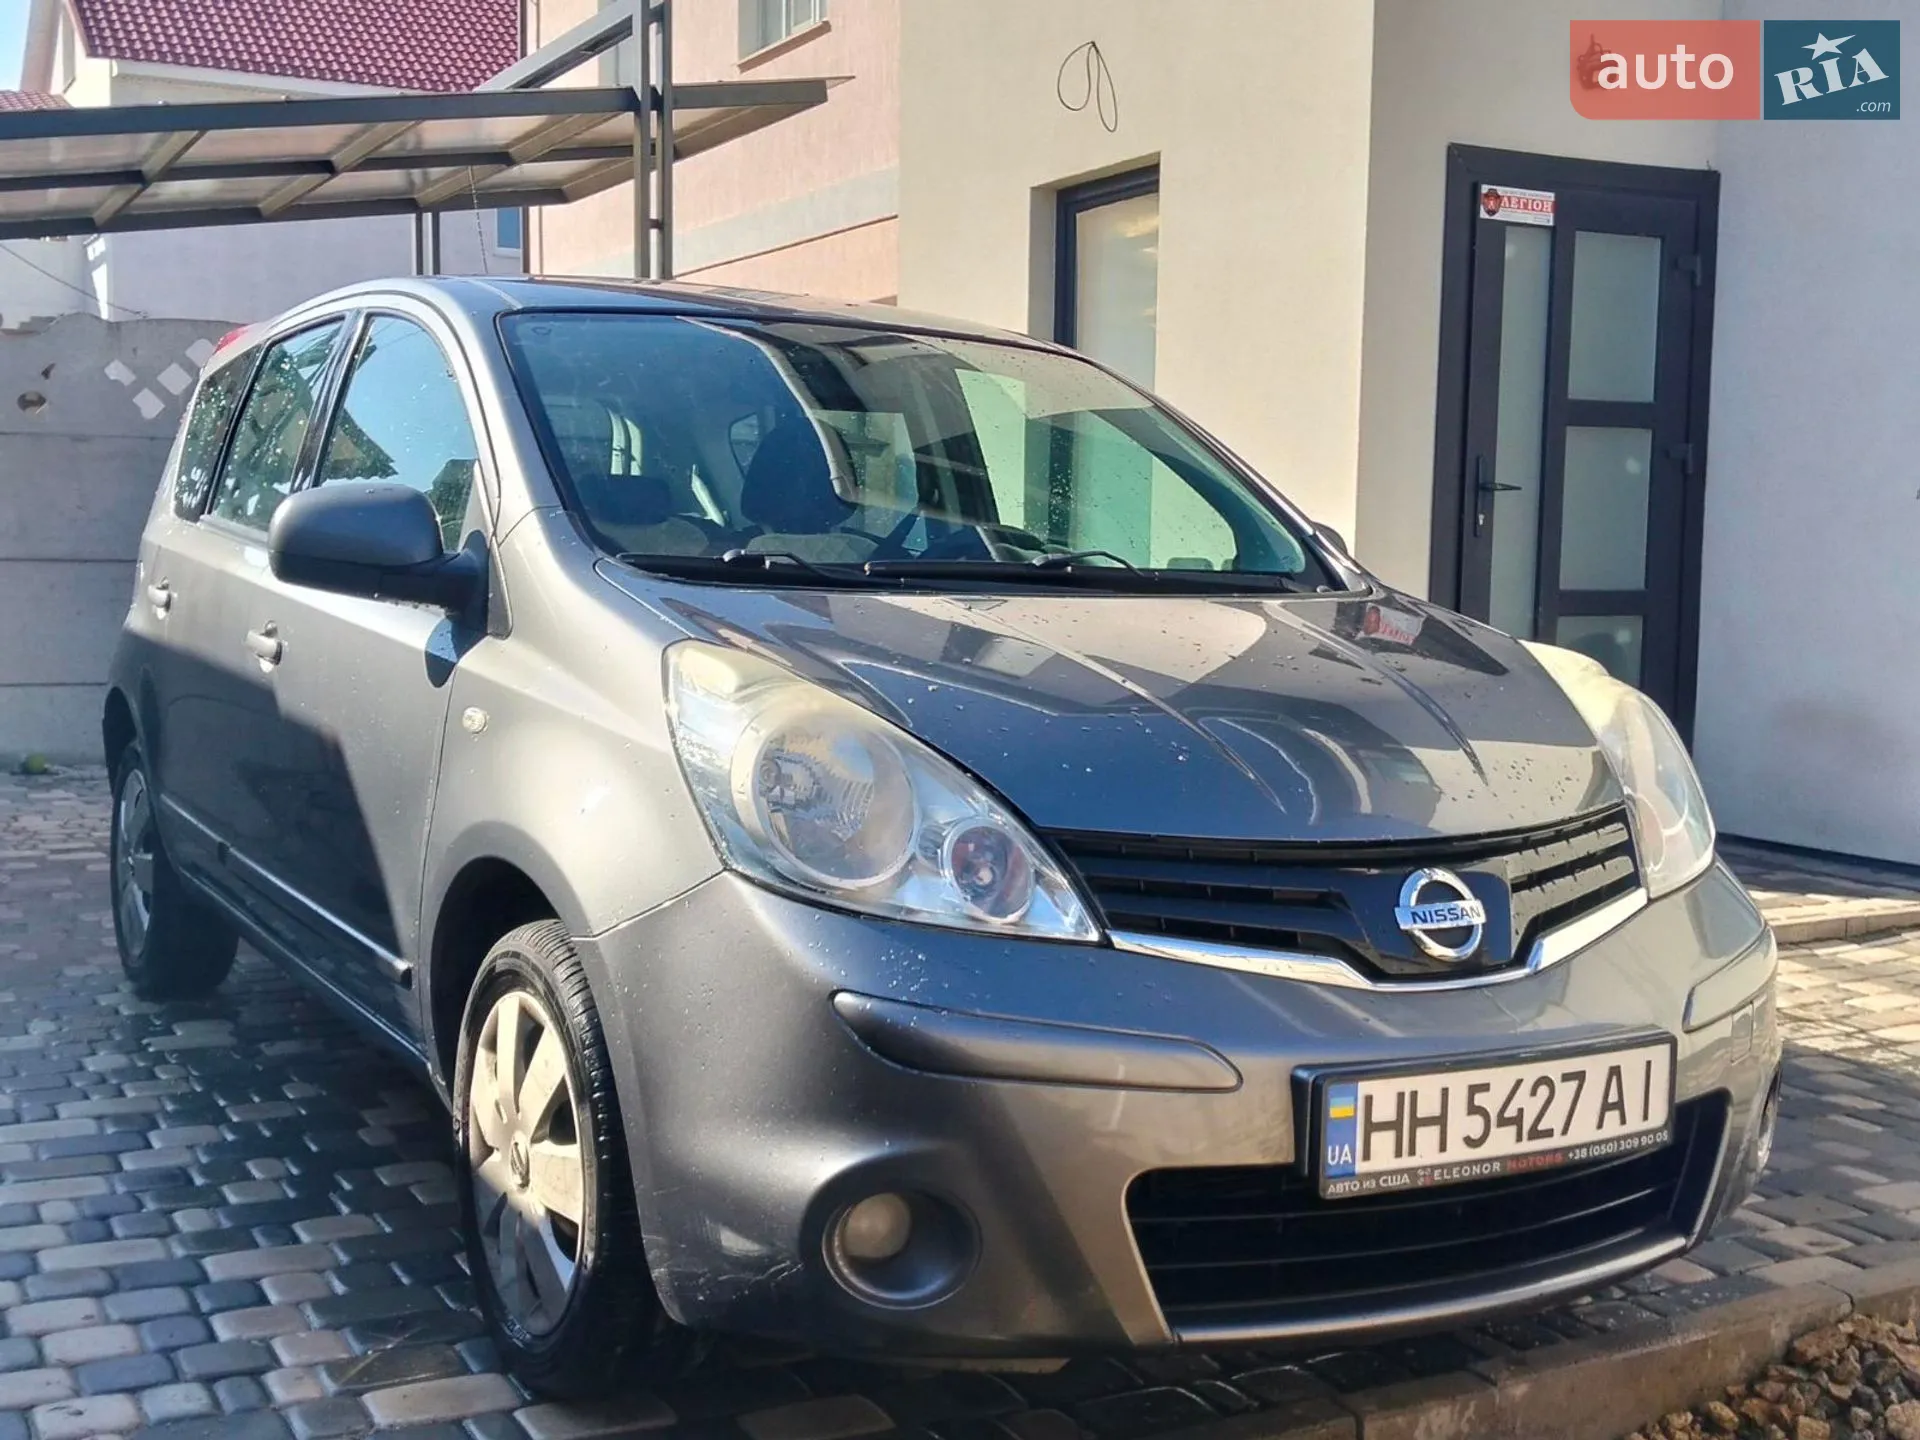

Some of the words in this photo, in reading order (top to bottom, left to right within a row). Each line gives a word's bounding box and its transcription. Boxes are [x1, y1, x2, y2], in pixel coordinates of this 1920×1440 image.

[1501, 195, 1553, 213] ЛЕГІОН
[1410, 906, 1482, 925] NISSAN
[1462, 1069, 1588, 1150] 5427
[1327, 1145, 1353, 1166] UA
[1433, 1162, 1501, 1180] ELEONOR
[1567, 1148, 1588, 1160] +38
[1589, 1140, 1618, 1156] (050)
[1327, 1180, 1360, 1195] АВТО
[1379, 1174, 1410, 1188] США
